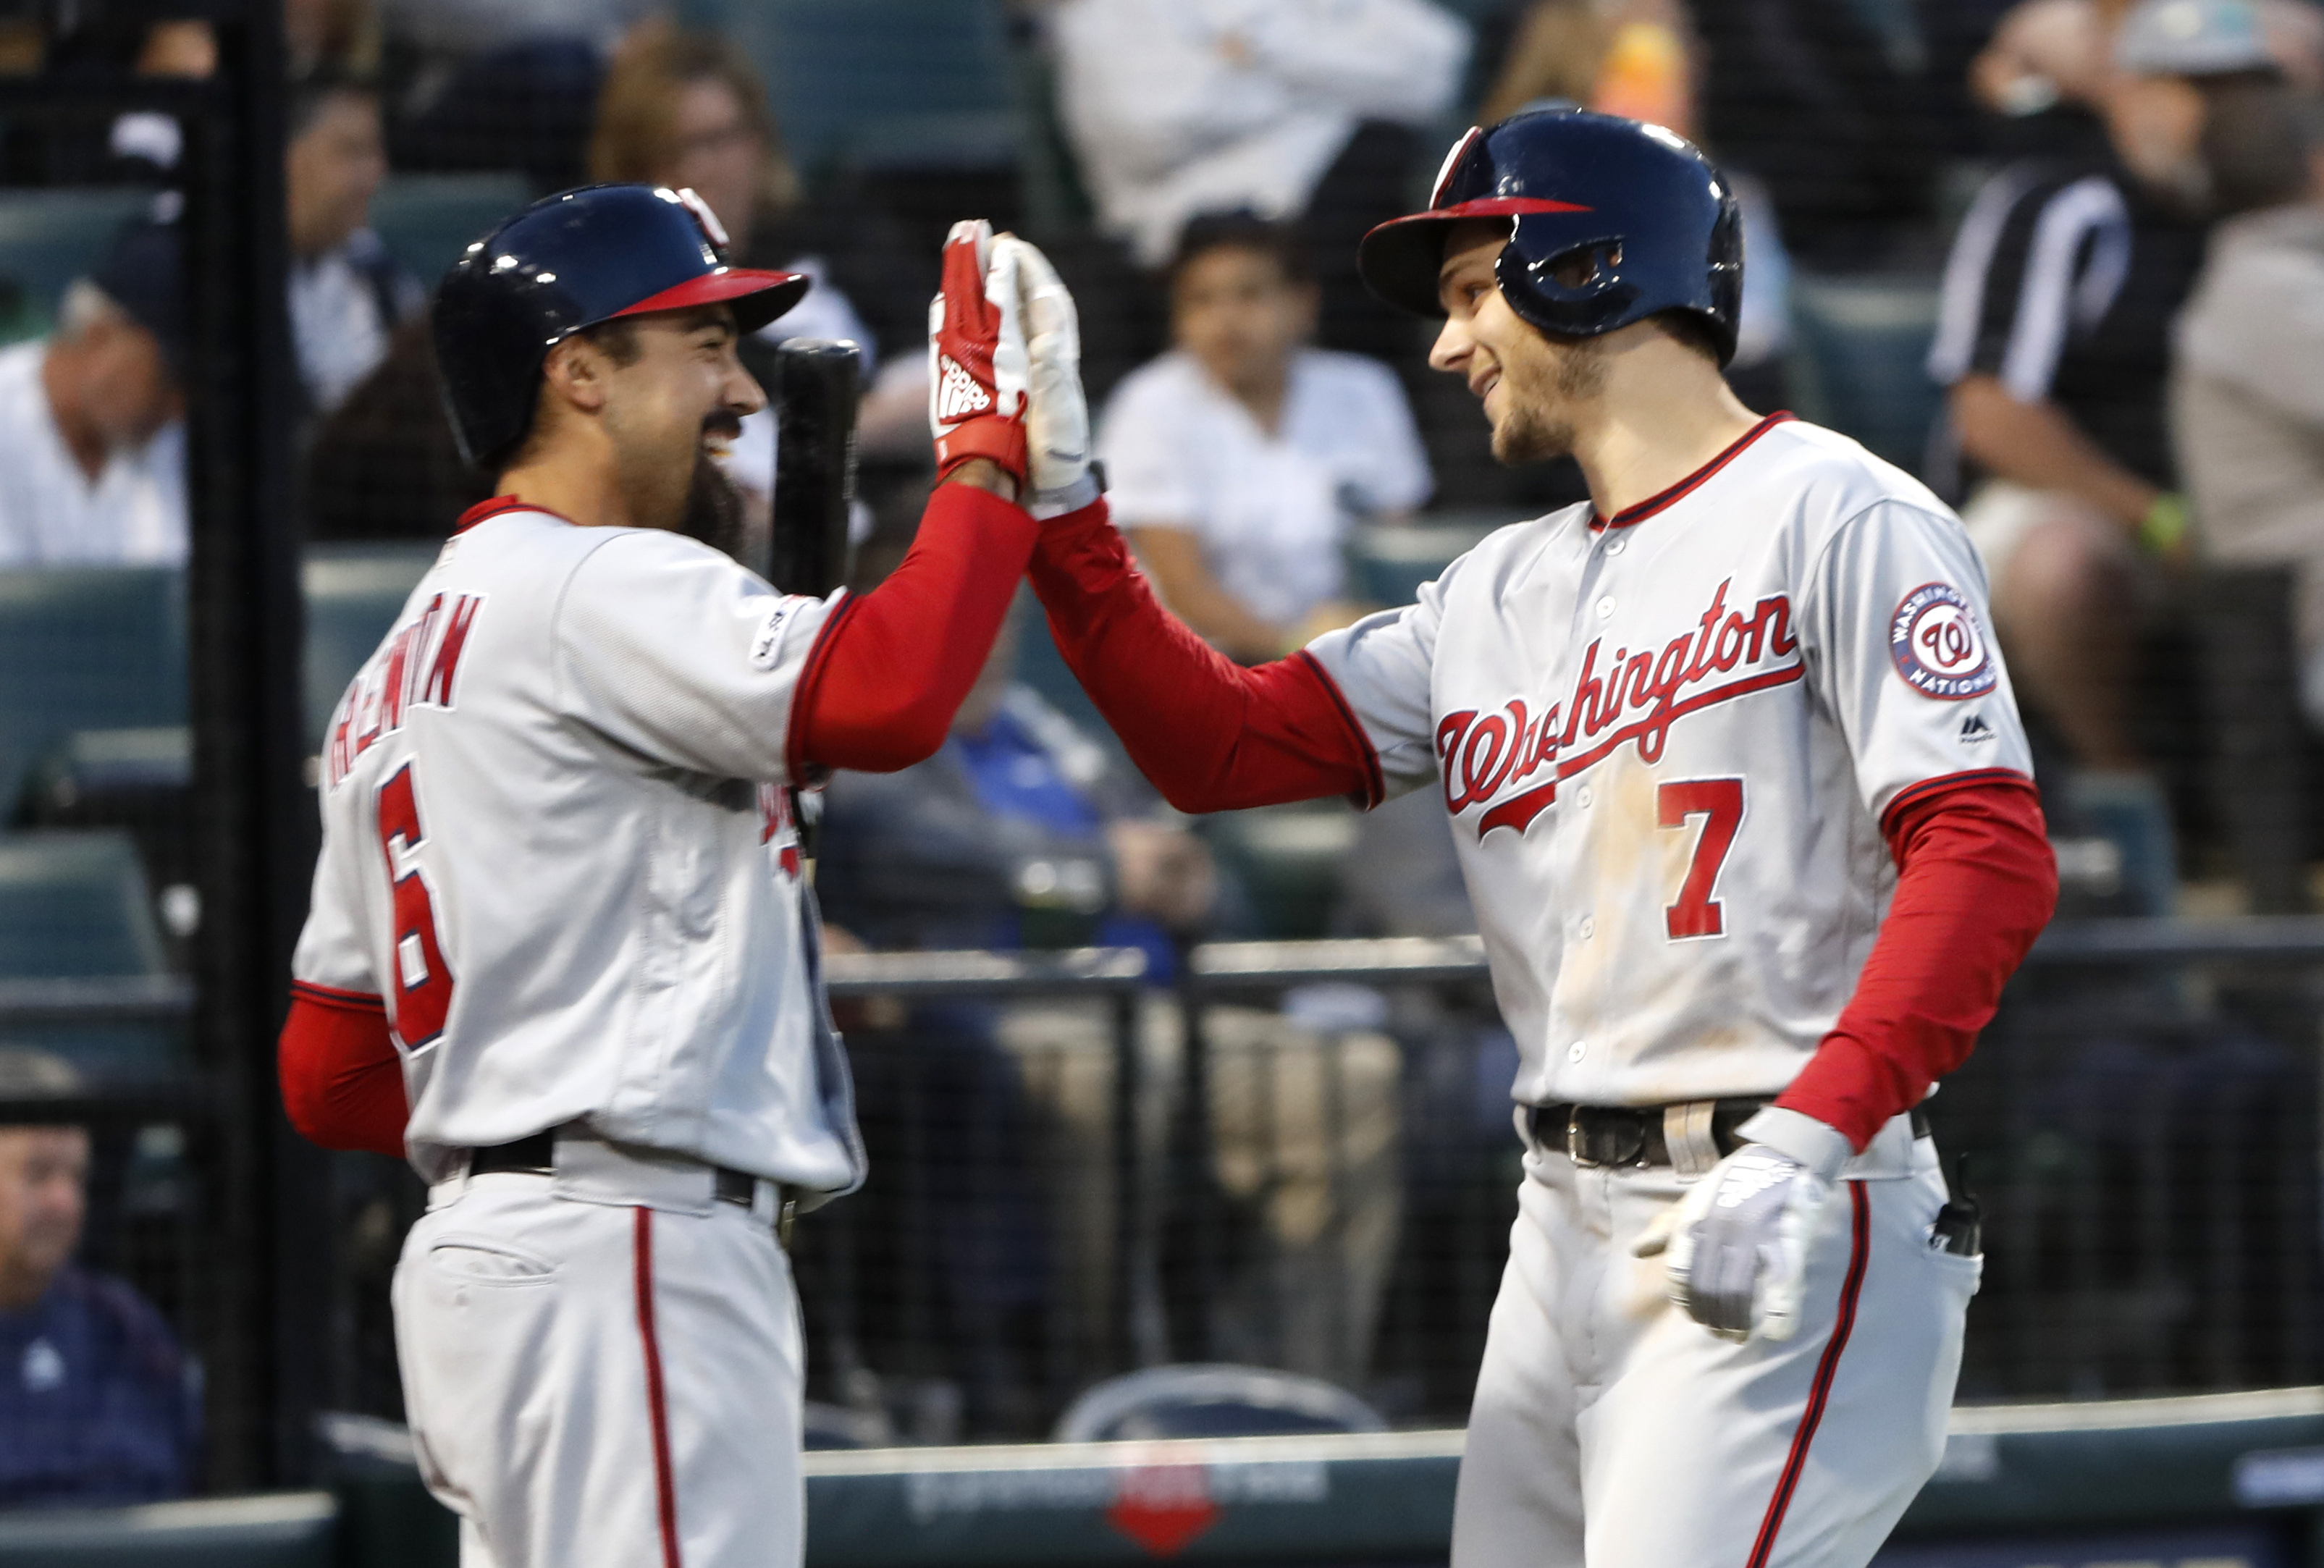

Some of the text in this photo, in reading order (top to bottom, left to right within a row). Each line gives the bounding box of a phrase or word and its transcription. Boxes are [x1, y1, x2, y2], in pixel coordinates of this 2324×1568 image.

[940, 353, 991, 411] adidas
[1892, 585, 1984, 644] WASHINGT
[1435, 575, 1806, 818] Washington
[1908, 657, 1998, 695] NATIO
[373, 752, 459, 1058] 6
[1656, 775, 1746, 943] 7
